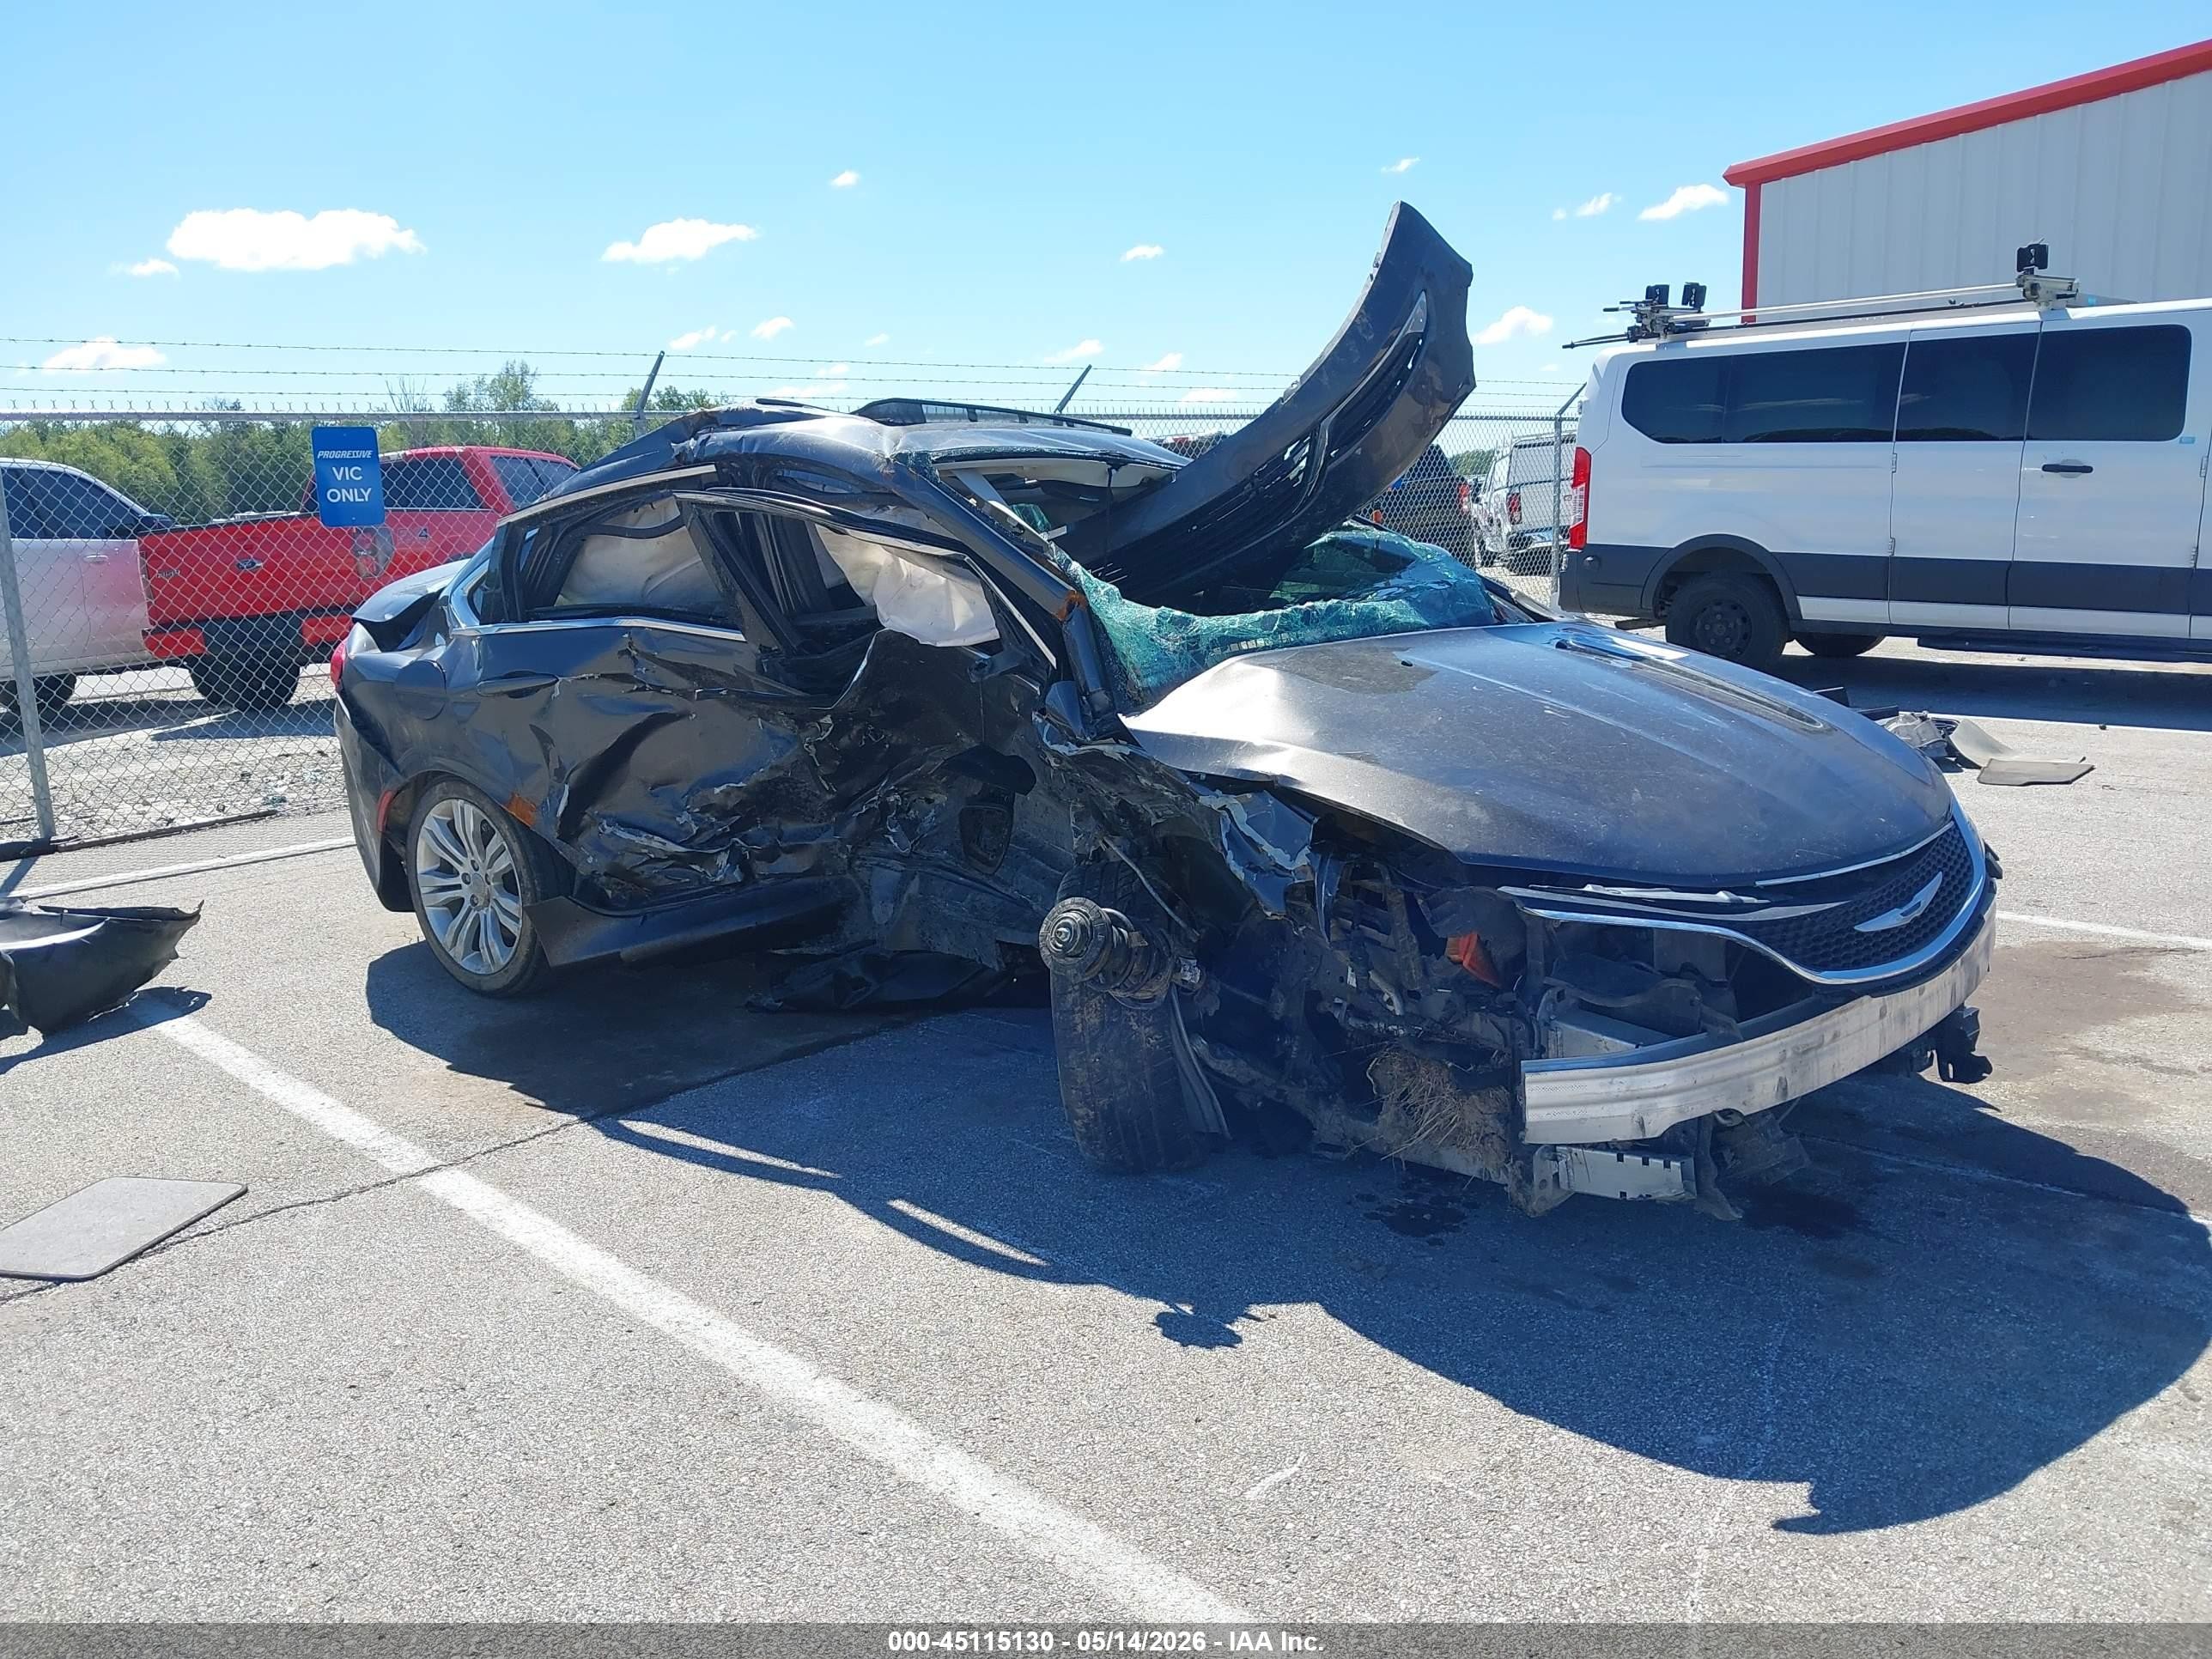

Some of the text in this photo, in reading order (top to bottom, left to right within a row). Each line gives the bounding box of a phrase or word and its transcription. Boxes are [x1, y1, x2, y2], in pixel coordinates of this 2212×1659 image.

[317, 450, 373, 459] PROGRESSIVE
[331, 466, 363, 481] VIC
[326, 488, 372, 502] ONLY
